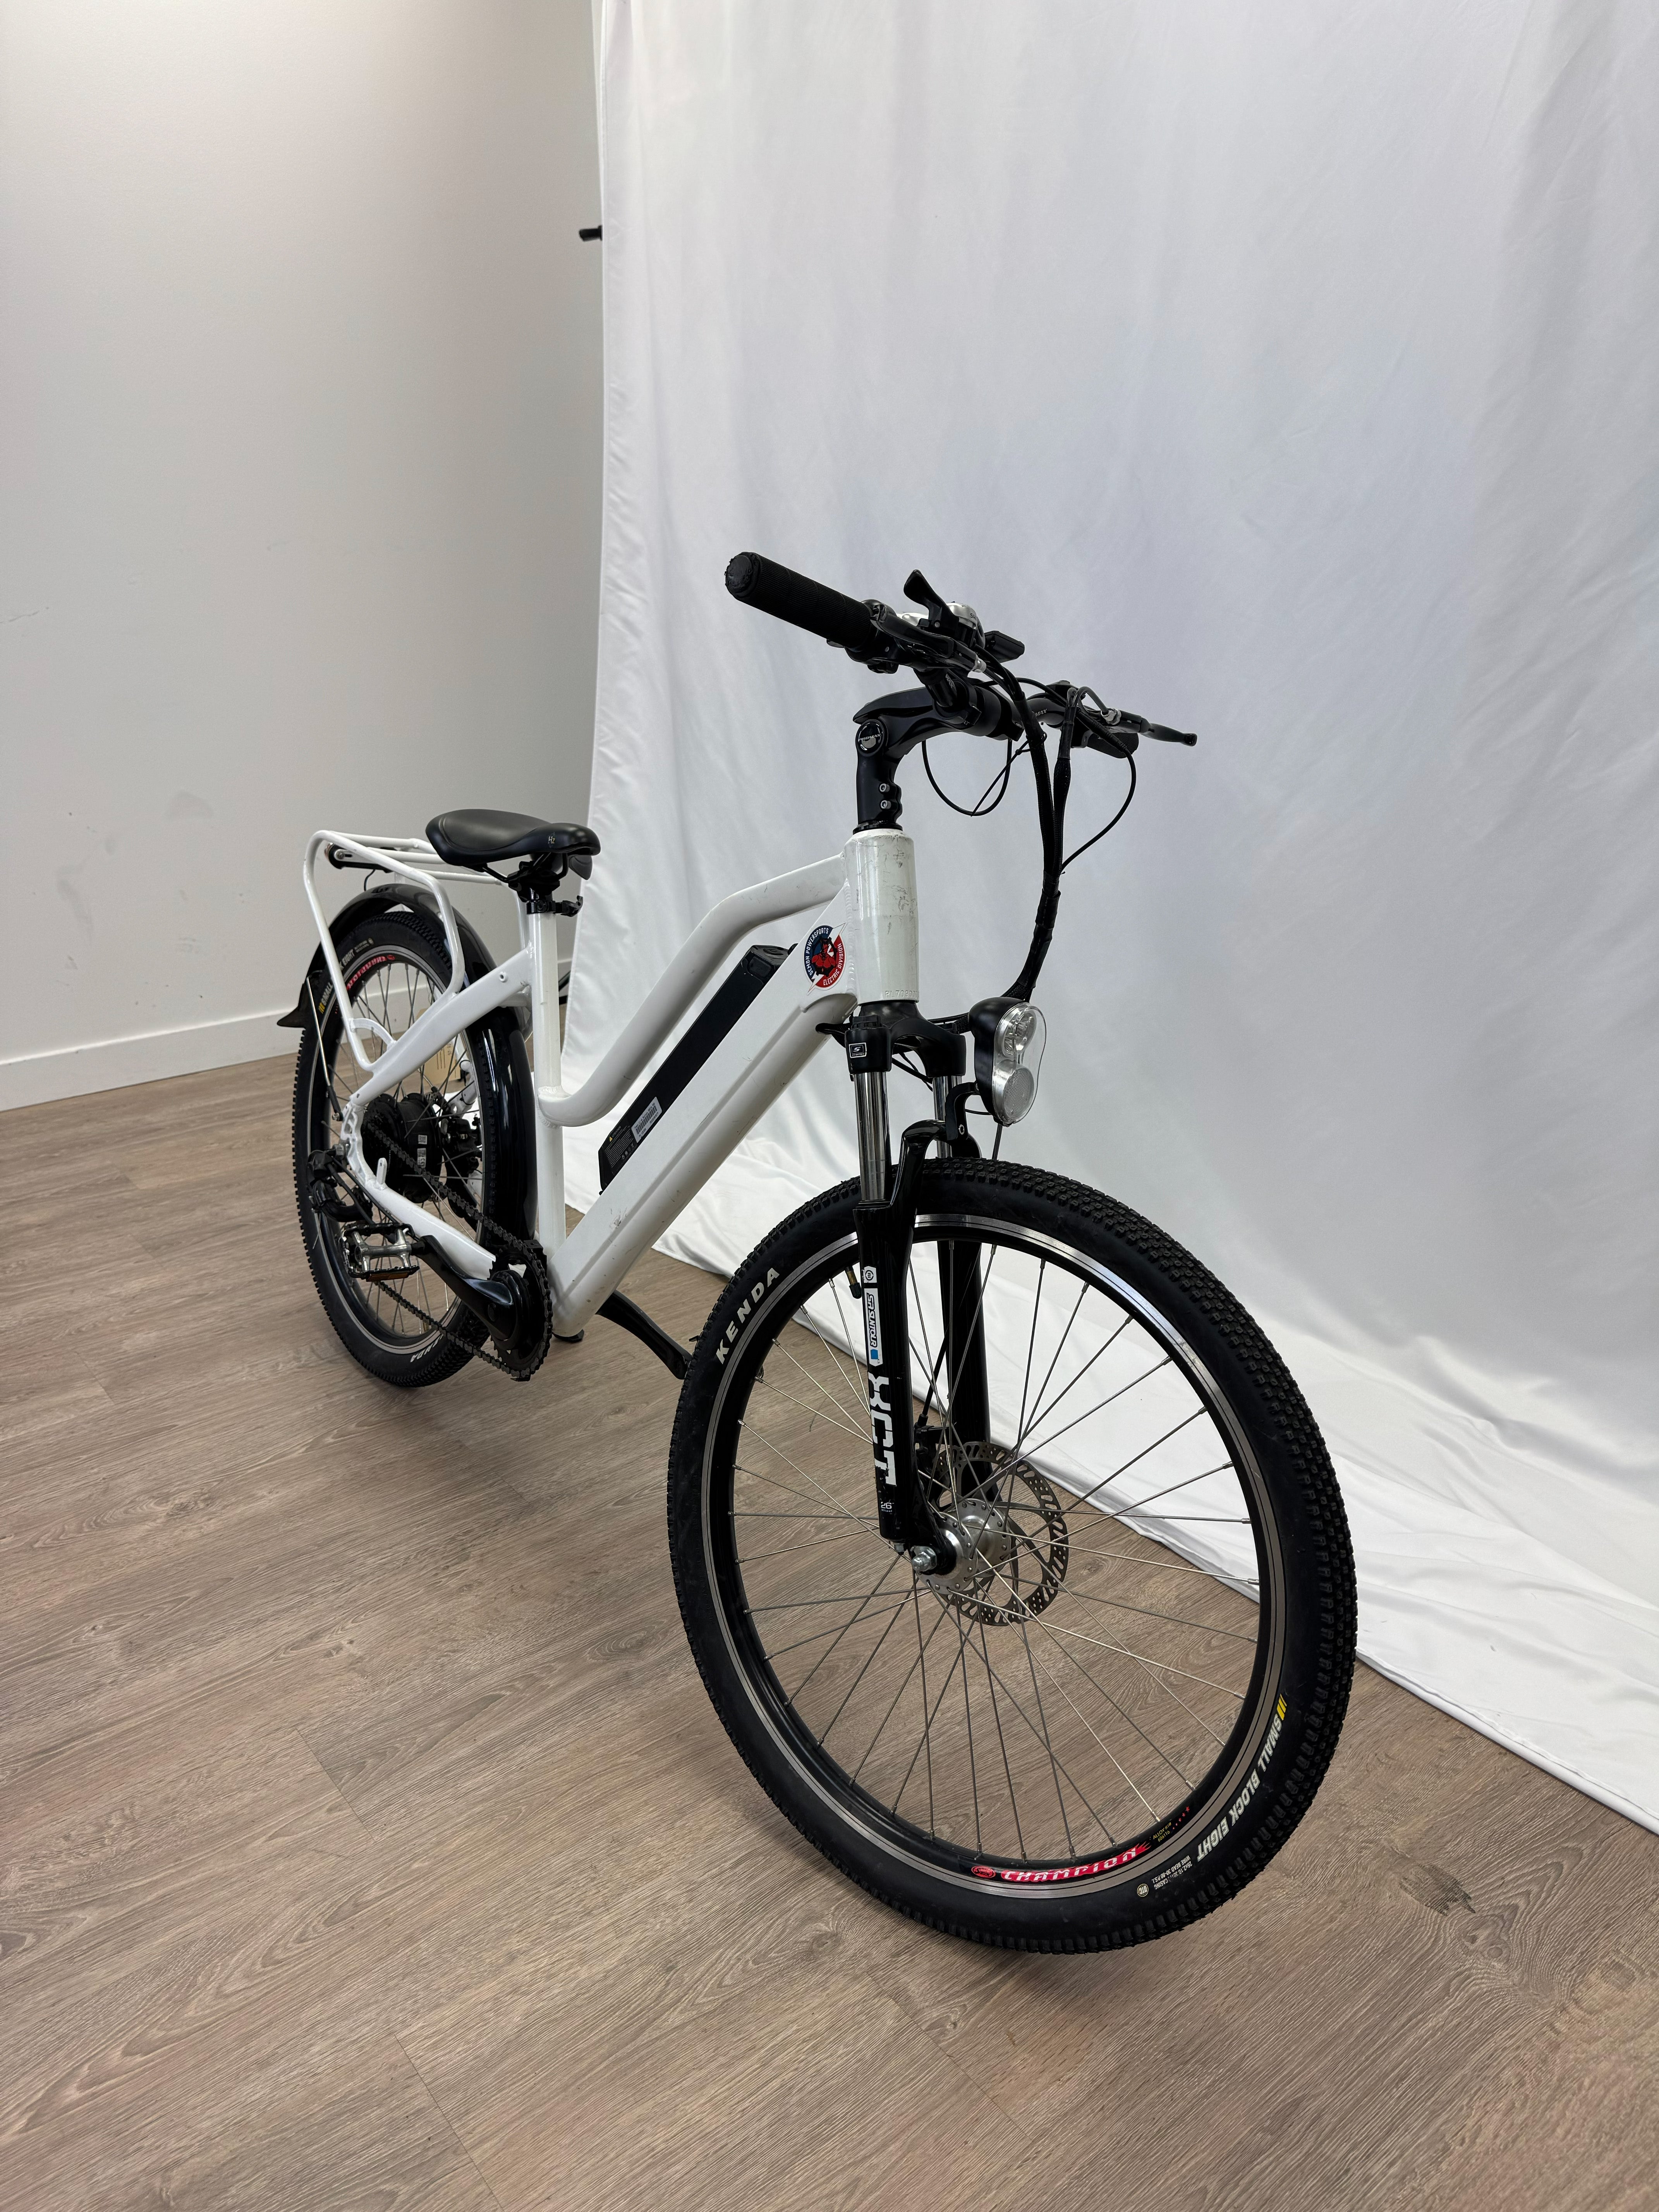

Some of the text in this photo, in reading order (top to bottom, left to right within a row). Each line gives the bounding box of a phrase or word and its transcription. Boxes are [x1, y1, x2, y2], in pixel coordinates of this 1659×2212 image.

[806, 927, 829, 954] POWERSPORTS
[342, 949, 355, 966] EIGHT
[823, 969, 840, 986] ELECTRIC
[716, 1267, 780, 1364] KENDA
[867, 1292, 878, 1348] SR SUNTOUR
[868, 1372, 897, 1487] XCT
[1197, 1714, 1282, 1862] SMALL BLOCK EIGHT
[1153, 1828, 1164, 1839] ALLOY
[1004, 1847, 1136, 1881] CHAMPION
[1171, 1862, 1181, 1872] BEAD
[1181, 1855, 1191, 1865] WIRE
[1154, 1861, 1193, 1889] 26x2.10 CASING
